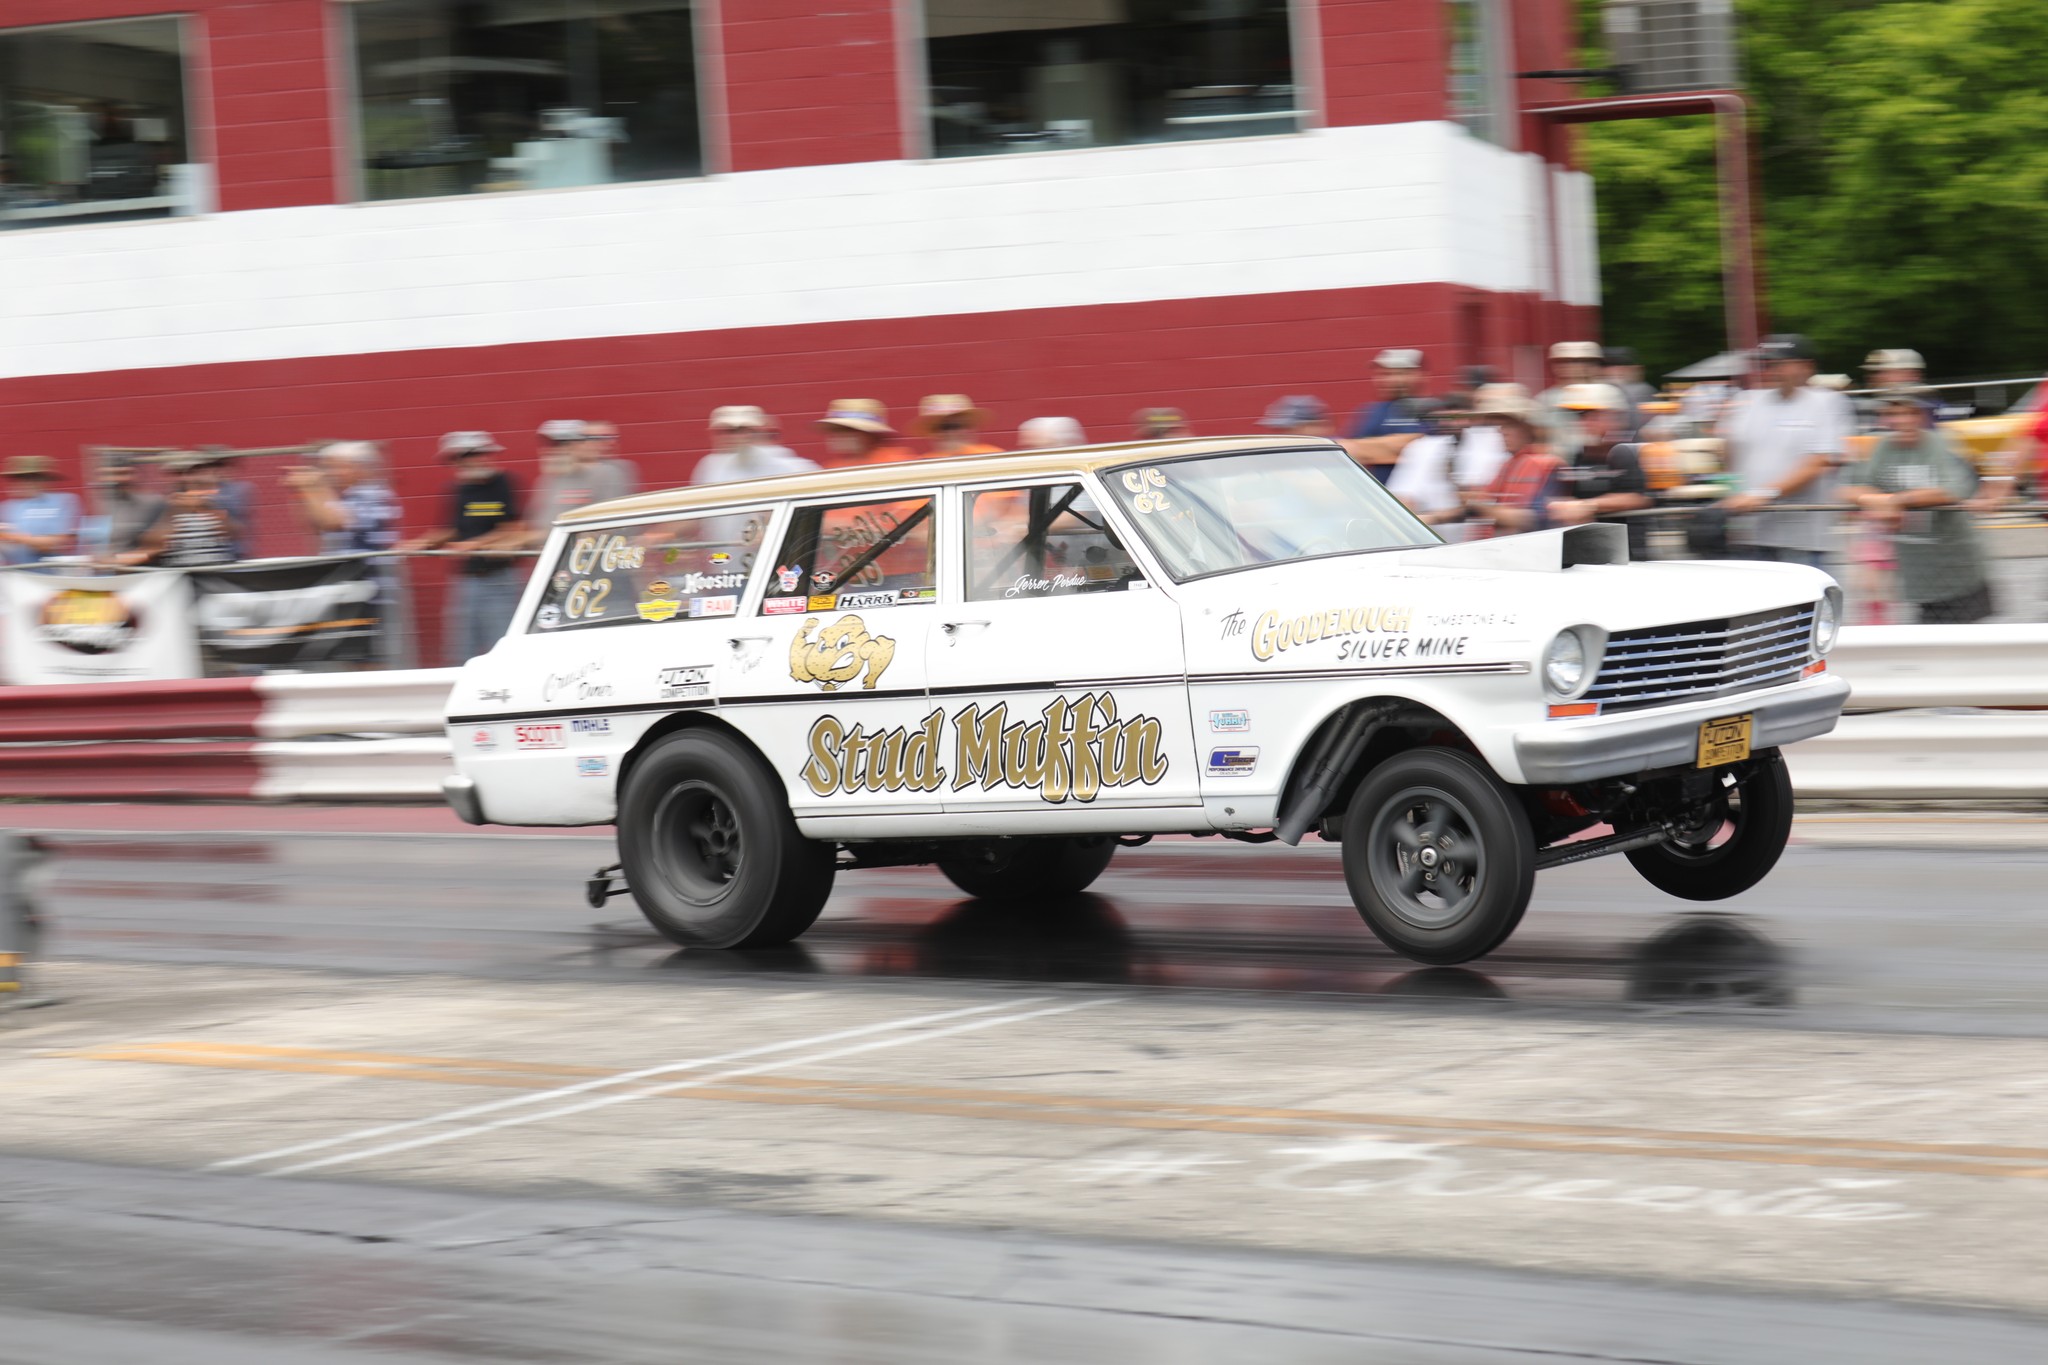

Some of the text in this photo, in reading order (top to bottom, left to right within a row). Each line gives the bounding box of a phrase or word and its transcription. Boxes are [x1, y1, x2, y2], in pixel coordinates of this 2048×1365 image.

[1122, 468, 1167, 493] C/G
[1134, 491, 1170, 513] 62
[569, 534, 646, 575] C/Gas
[565, 578, 612, 619] 62
[767, 598, 806, 608] WHITE
[840, 594, 894, 606] HARRIS
[1426, 613, 1496, 627] TOMBSTONE
[1221, 606, 1415, 662] The GOODENOUGH
[1337, 637, 1469, 661] SILVER MINE
[660, 686, 710, 699] COMPETITION
[515, 726, 563, 742] SCOTT
[571, 719, 611, 732] MAHLE
[800, 691, 1169, 804] Stud Muffin
